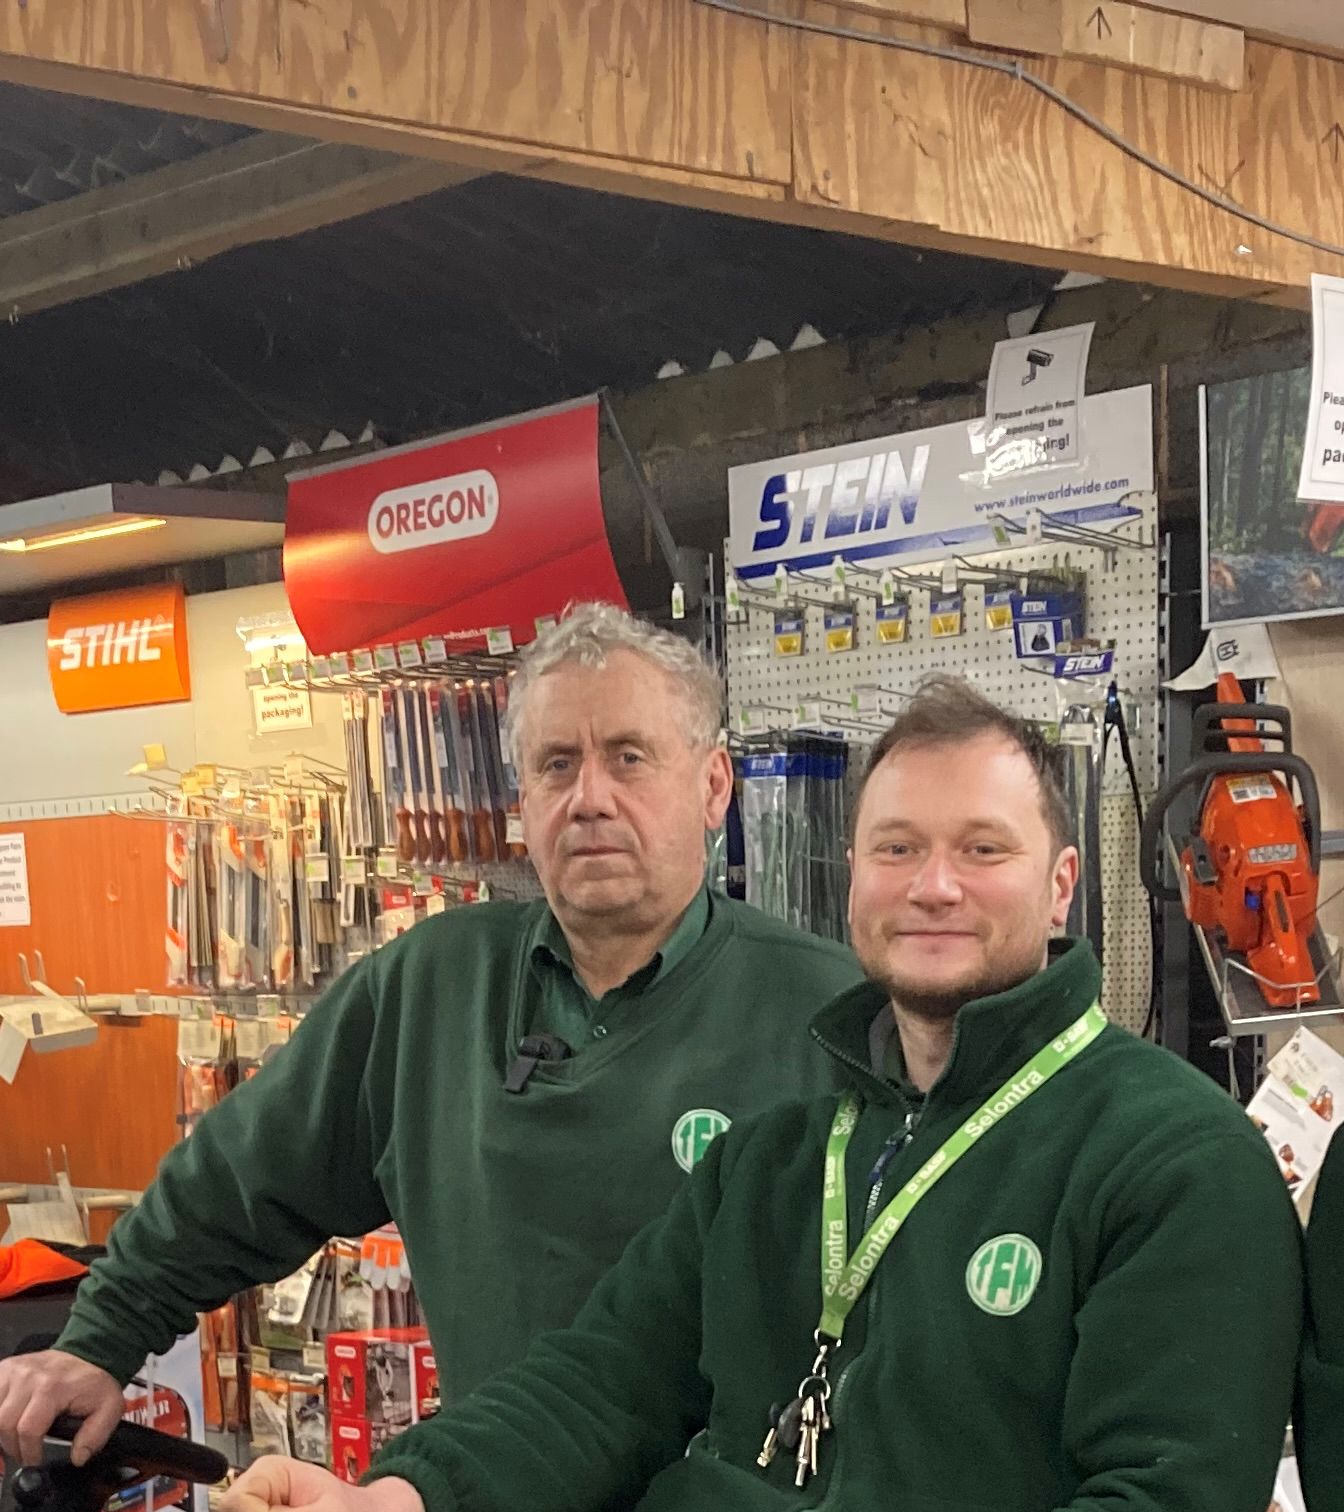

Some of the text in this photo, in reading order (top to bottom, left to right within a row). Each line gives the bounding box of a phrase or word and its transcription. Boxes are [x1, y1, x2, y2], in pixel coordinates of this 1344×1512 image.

[994, 399, 1076, 421] Please refrain from
[1047, 417, 1064, 428] the
[376, 484, 486, 539] OREGON
[752, 444, 931, 552] STEIN
[973, 478, 1130, 513] www.steinworldwide.com
[59, 616, 162, 672] STIHL
[1063, 654, 1106, 674] STEIN
[261, 705, 304, 721] packaging!
[831, 1098, 858, 1137] Selo
[963, 1069, 1045, 1138] Selontra
[838, 1214, 900, 1301] Selontra
